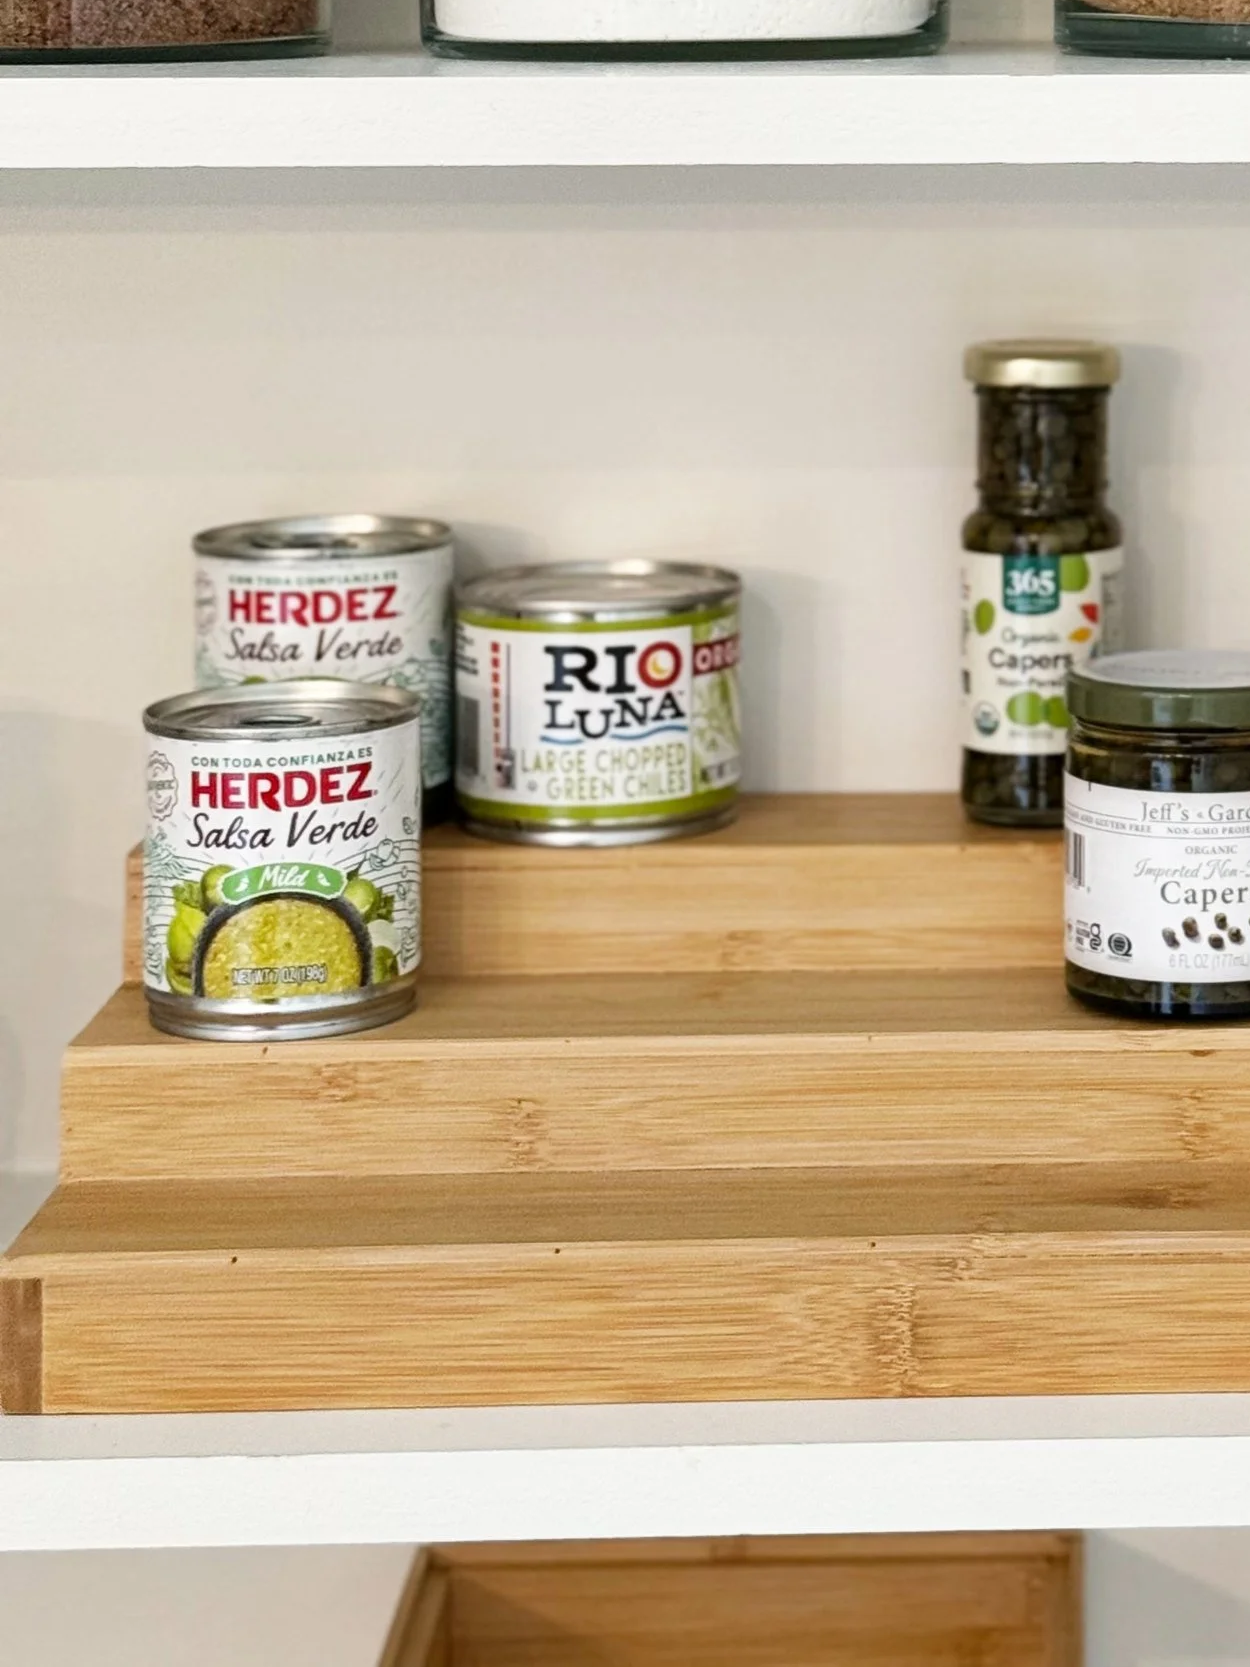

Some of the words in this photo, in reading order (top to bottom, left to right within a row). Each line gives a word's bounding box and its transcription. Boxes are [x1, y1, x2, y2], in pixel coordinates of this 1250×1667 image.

[1006, 567, 1057, 596] 365
[228, 585, 398, 627] HERDEZ
[225, 627, 303, 663] Salsa
[314, 627, 404, 663] Verde
[544, 640, 684, 695] RIO
[544, 690, 687, 740] LUNA
[191, 755, 219, 768] CON
[223, 756, 263, 769] TODA
[266, 748, 354, 769] CONFIANZA
[357, 746, 373, 759] ES
[521, 750, 588, 776] LARGE
[595, 742, 687, 773] CHOPPED
[191, 761, 373, 812] HERDEZ
[546, 774, 614, 801] GREEN
[624, 768, 687, 798] CHILES
[187, 811, 275, 850] Salsa
[286, 809, 380, 848] Verde
[1129, 822, 1153, 833] FREE
[1184, 845, 1239, 855] ORGANIC
[258, 865, 311, 891] Mild
[1133, 857, 1203, 883] Imported
